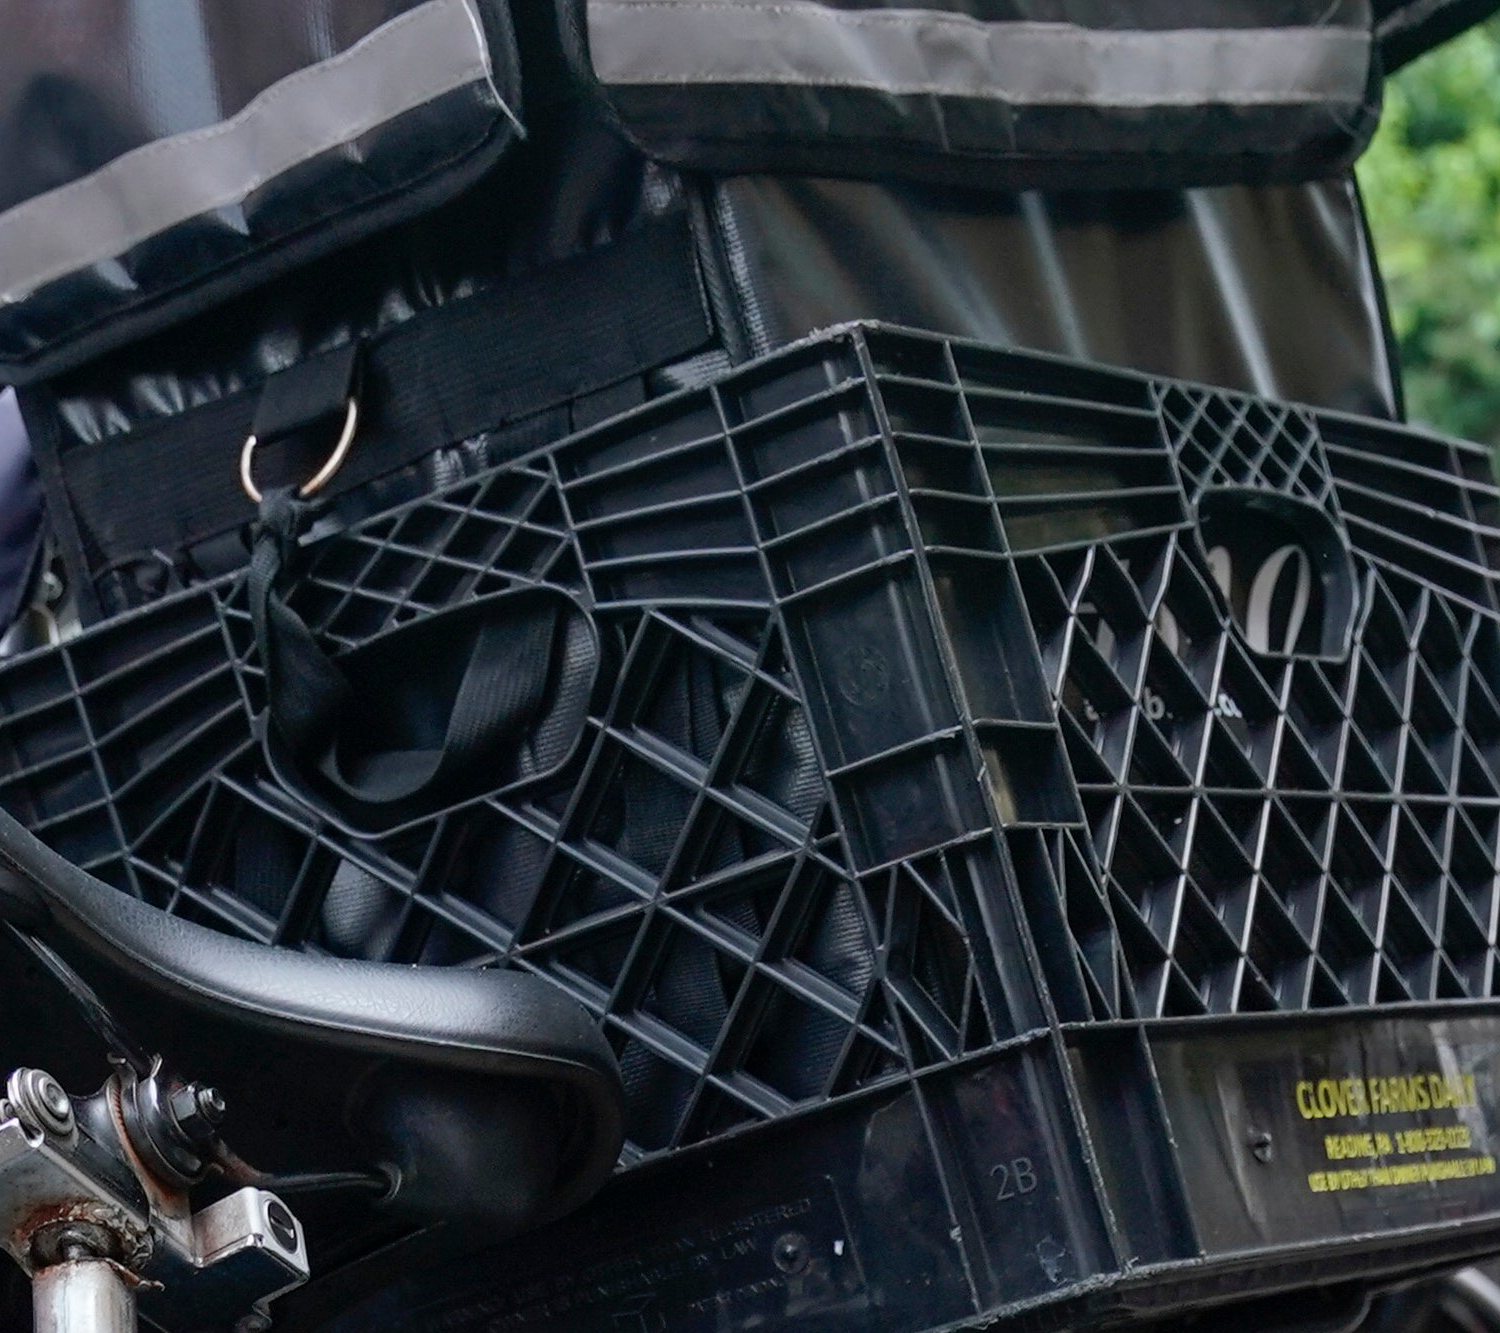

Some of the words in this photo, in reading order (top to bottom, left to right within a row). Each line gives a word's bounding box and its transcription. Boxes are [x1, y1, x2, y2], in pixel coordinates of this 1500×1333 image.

[1296, 1078, 1370, 1119] CLOVER
[1368, 1076, 1431, 1115] FARMS
[989, 1156, 1038, 1201] 2B
